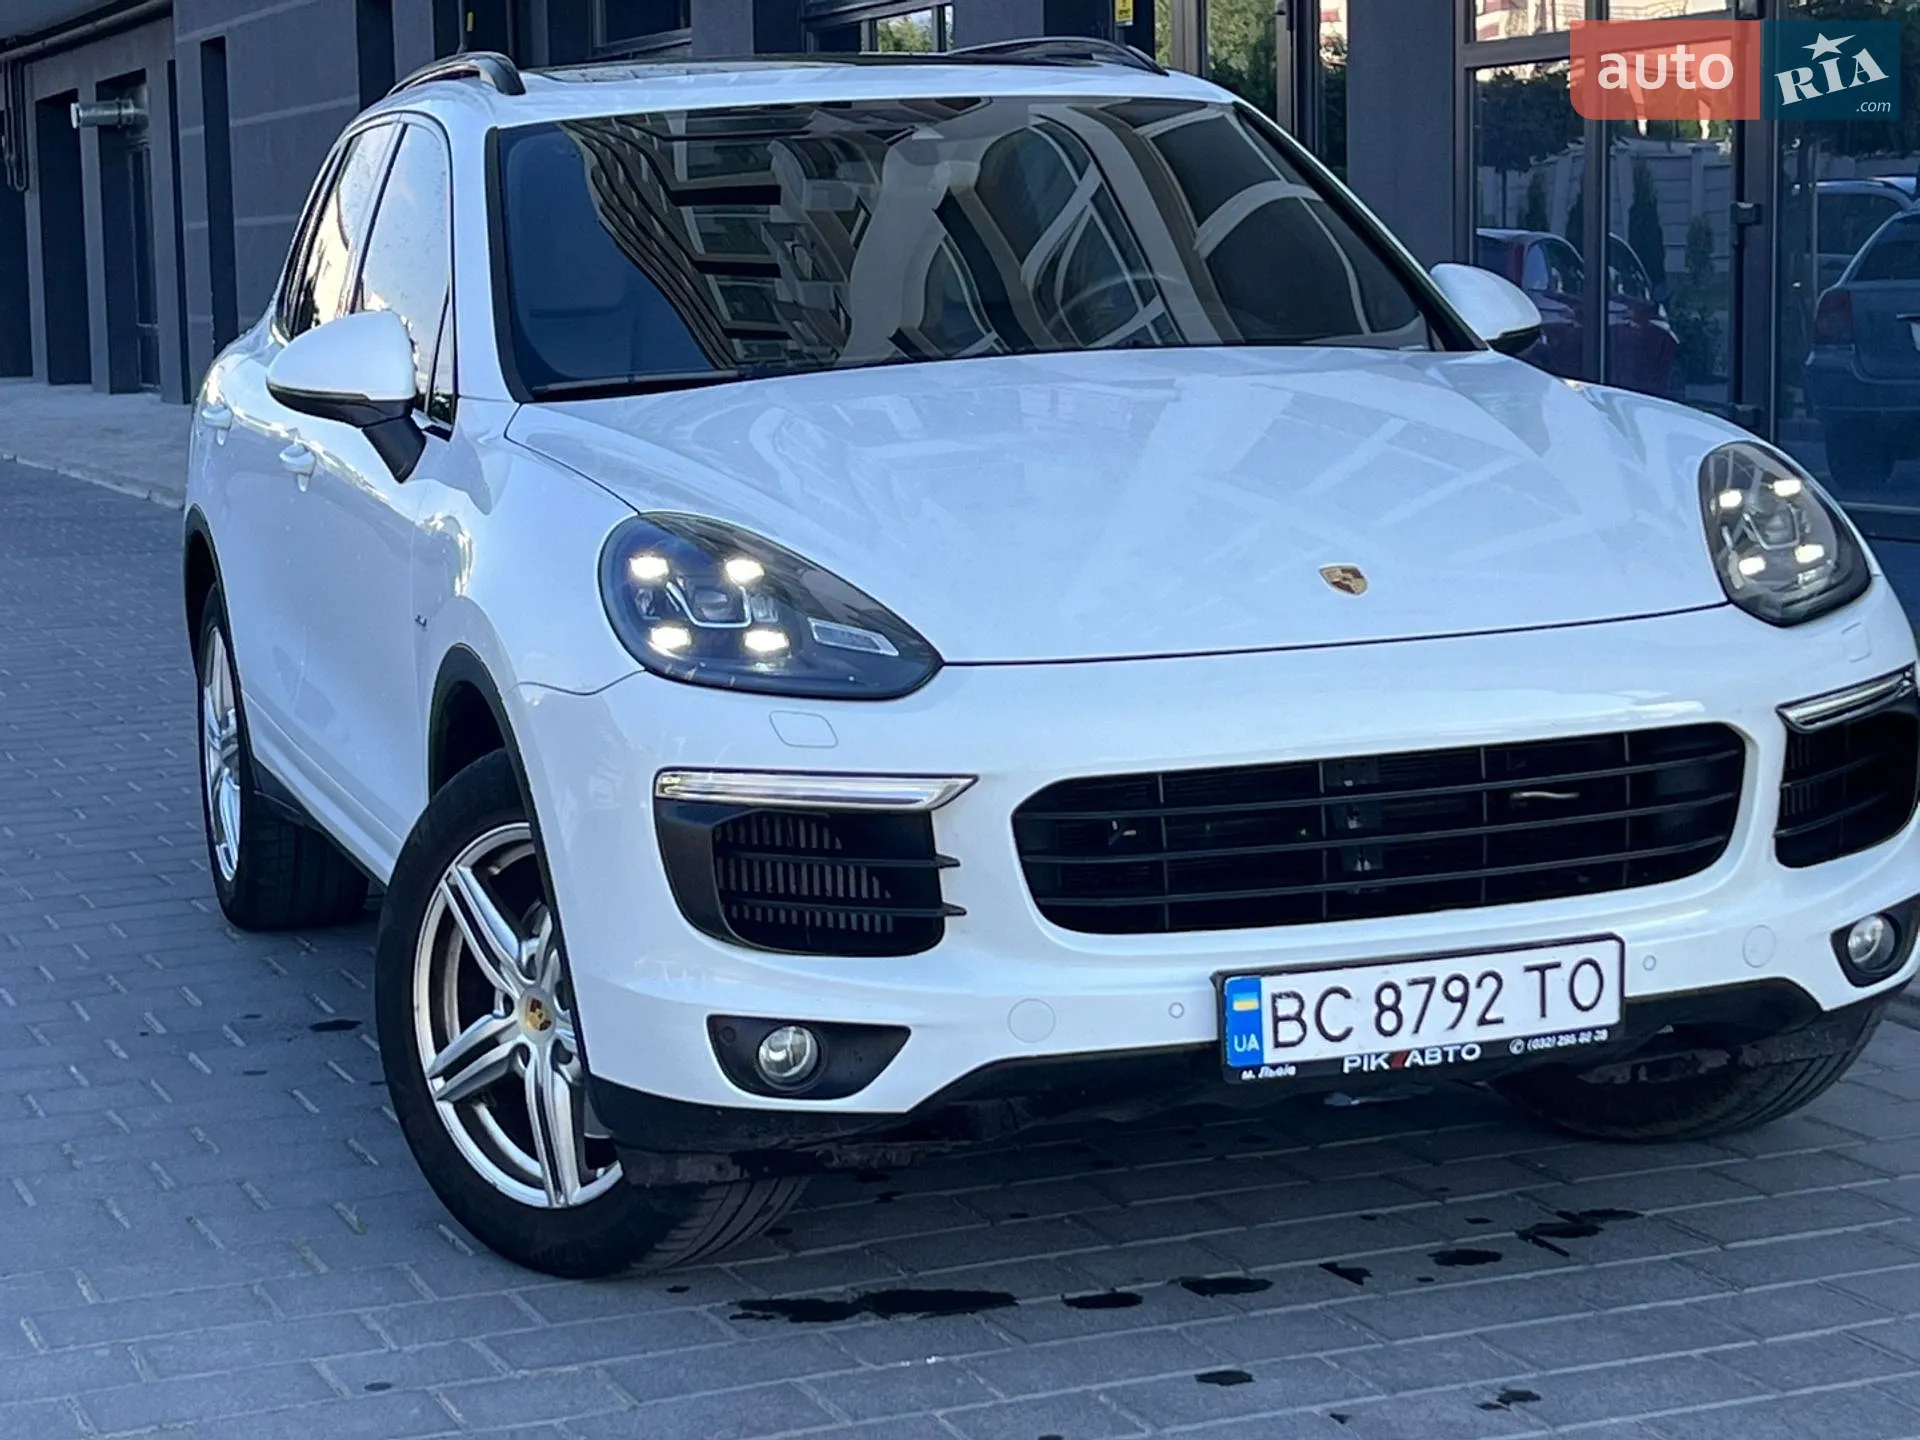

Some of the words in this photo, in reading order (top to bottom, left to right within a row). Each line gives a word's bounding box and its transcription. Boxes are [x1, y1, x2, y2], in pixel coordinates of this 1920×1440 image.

[1271, 986, 1354, 1049] BC
[1374, 970, 1505, 1037] 8792
[1523, 957, 1604, 1018] TO
[1233, 1033, 1260, 1052] UA
